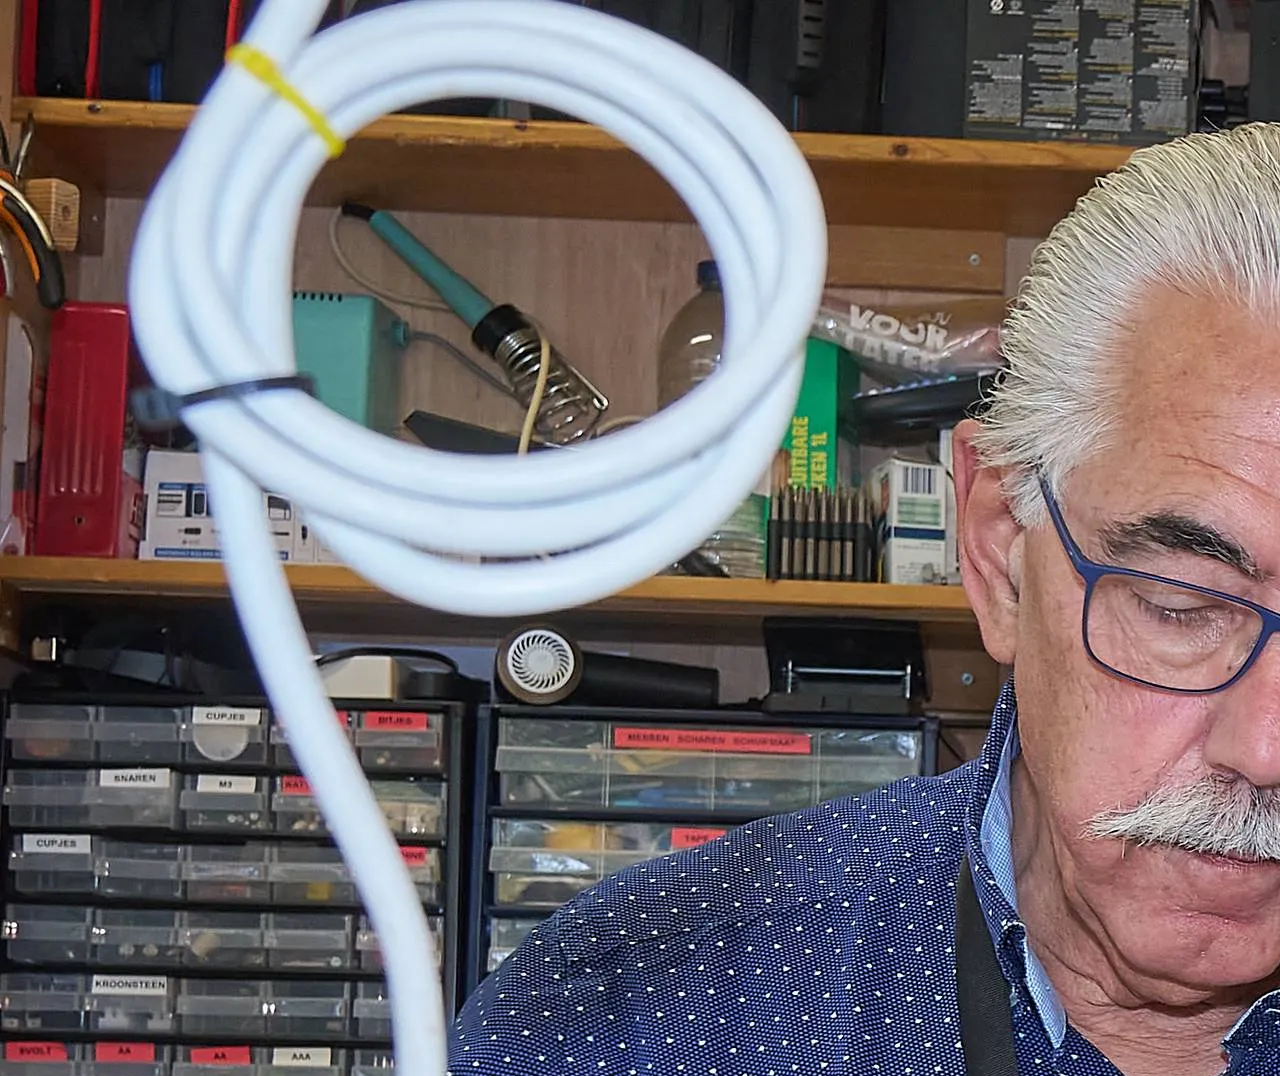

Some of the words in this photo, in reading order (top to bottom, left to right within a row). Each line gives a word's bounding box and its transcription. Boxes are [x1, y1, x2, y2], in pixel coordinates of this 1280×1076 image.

[205, 711, 246, 722] CUPJES
[113, 773, 157, 784] SNAREN
[36, 838, 77, 849] CUPJES
[95, 979, 166, 991] KROONSTEEN
[117, 1045, 131, 1056] AA
[212, 1051, 227, 1062] AA
[291, 1051, 311, 1062] AAA
